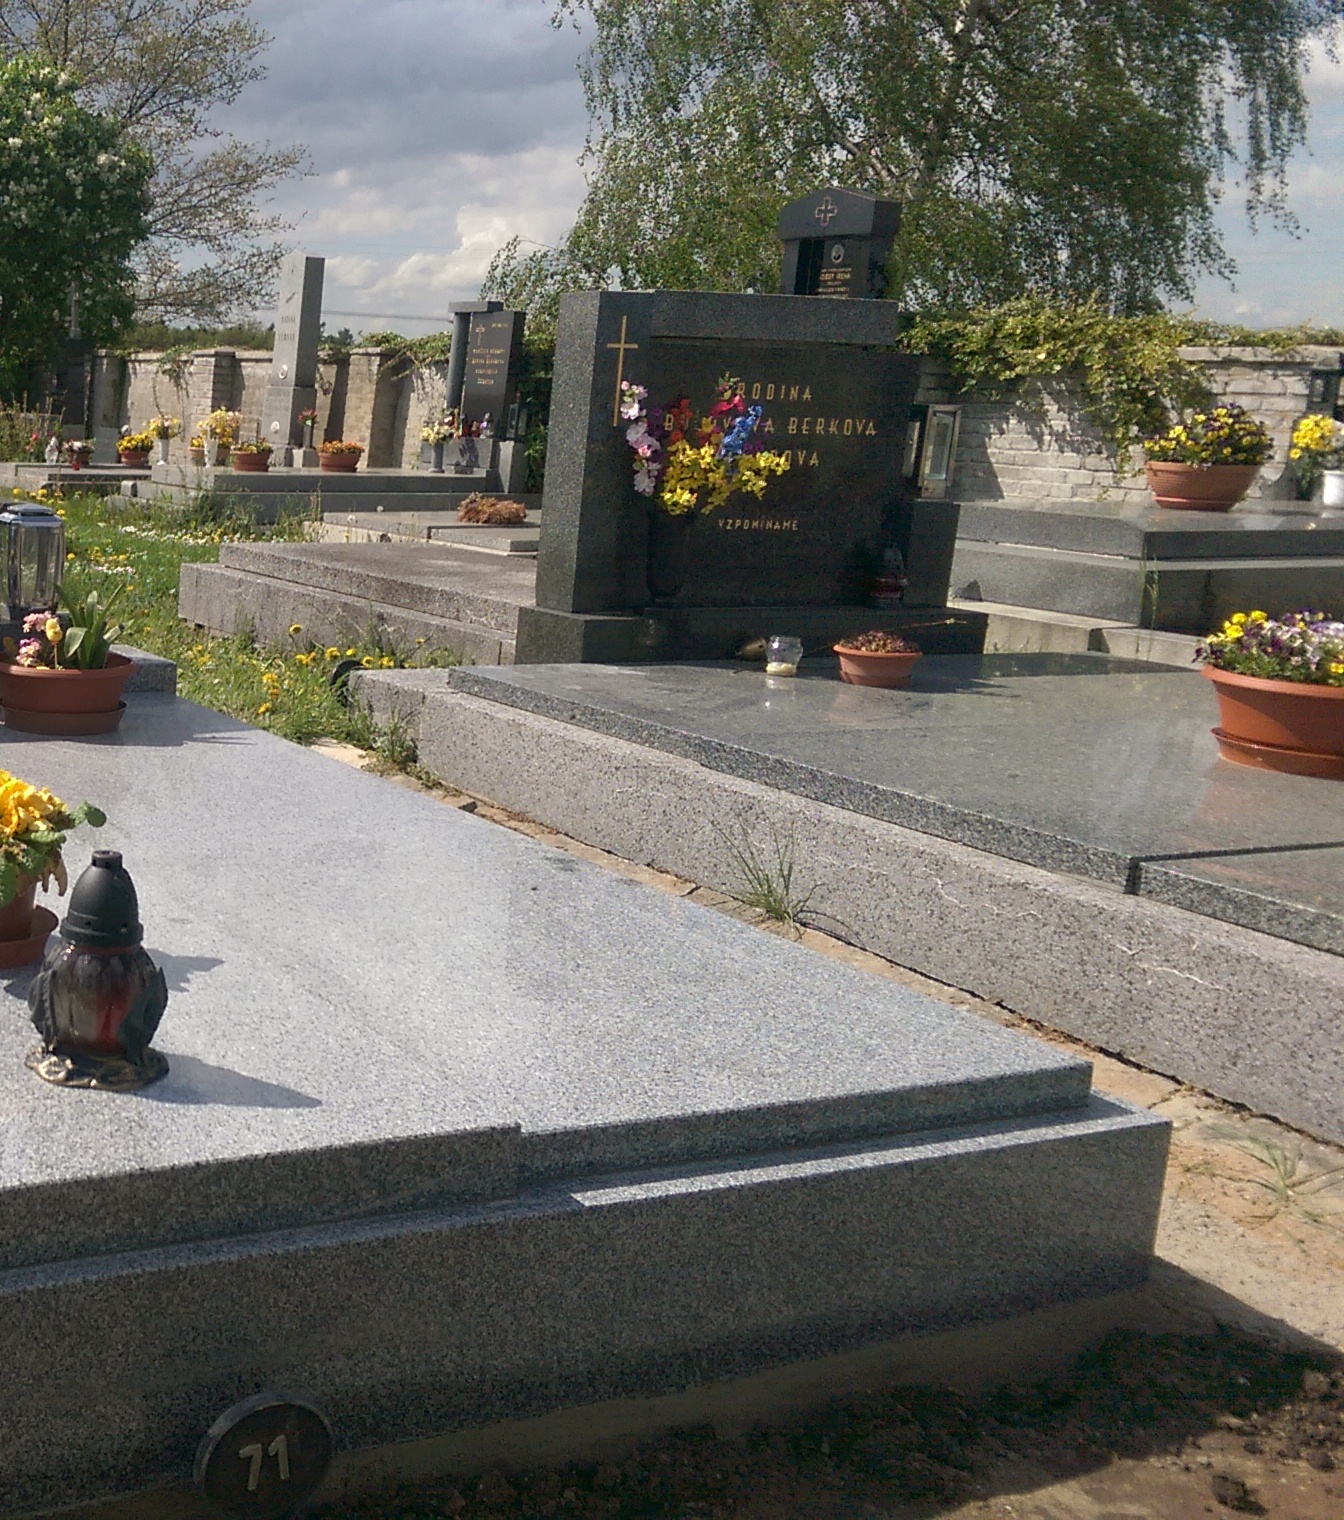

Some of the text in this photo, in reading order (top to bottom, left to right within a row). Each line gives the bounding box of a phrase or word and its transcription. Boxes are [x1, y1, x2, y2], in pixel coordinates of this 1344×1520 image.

[737, 382, 813, 401] RODINA
[787, 417, 877, 437] BERKOVA
[238, 1434, 290, 1492] 71
